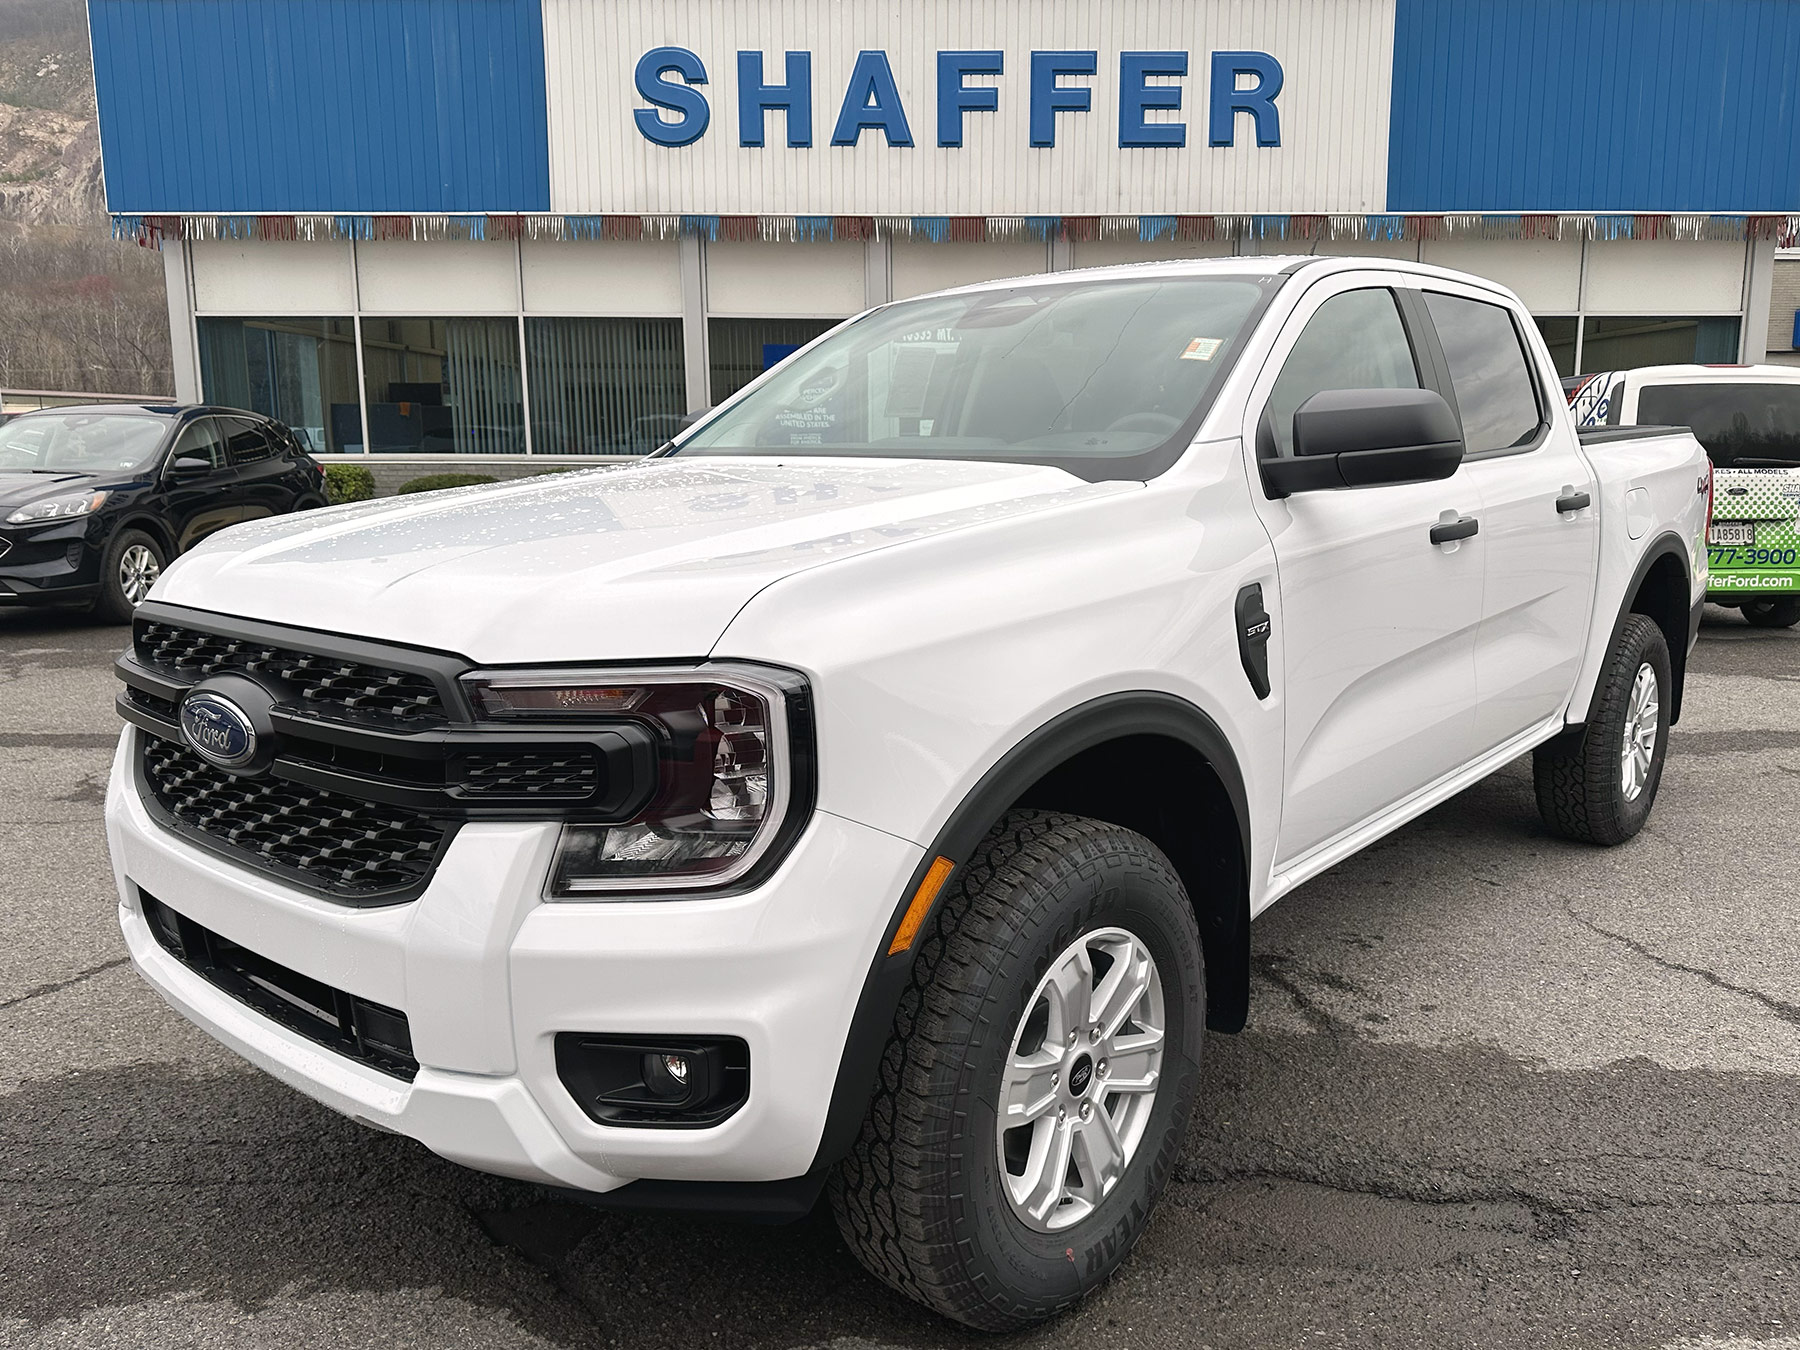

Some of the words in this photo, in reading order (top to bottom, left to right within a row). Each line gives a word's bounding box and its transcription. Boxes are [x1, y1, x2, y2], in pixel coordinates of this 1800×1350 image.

[633, 46, 1285, 148] SHAFFER
[775, 413, 813, 421] ASSEMBLED
[780, 420, 806, 428] UNITED
[192, 707, 232, 750] Ford
[1083, 1069, 1197, 1278] GOODYEAR
